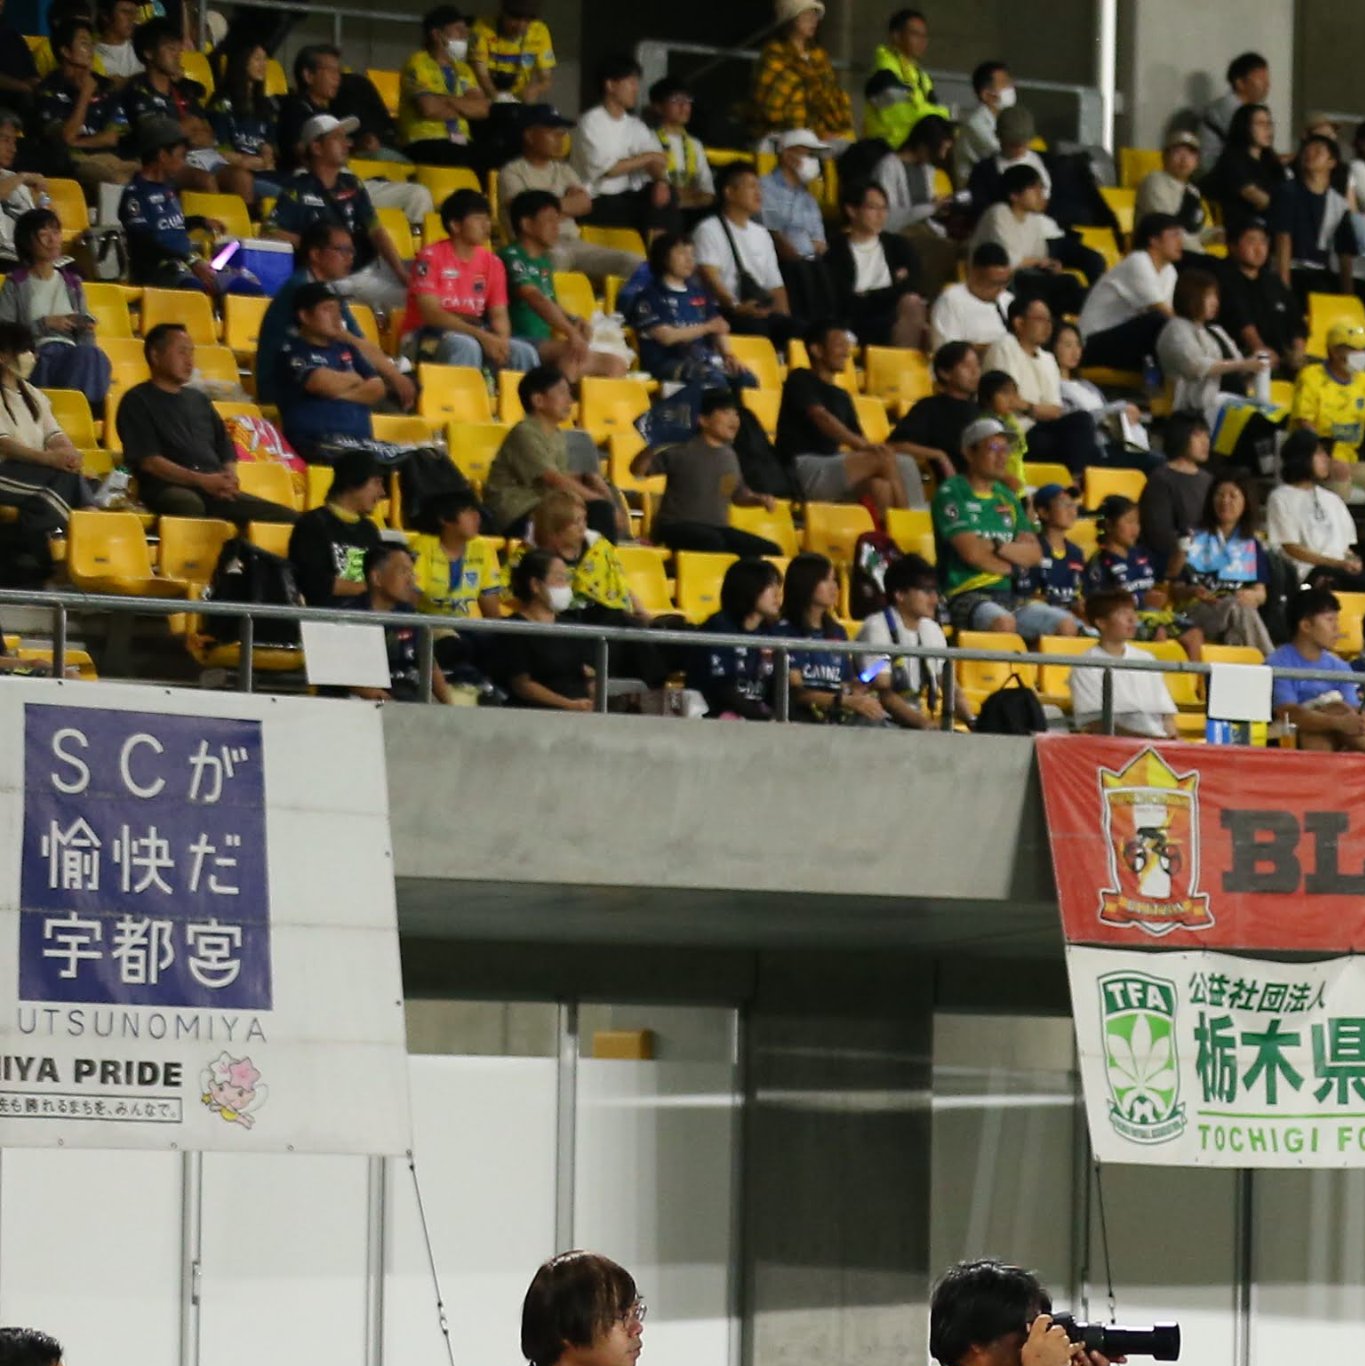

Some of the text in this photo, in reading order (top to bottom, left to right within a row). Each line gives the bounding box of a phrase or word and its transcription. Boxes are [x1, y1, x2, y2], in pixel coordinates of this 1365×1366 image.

[51, 728, 248, 802] SCが
[41, 816, 241, 896] 愉快だ
[42, 911, 242, 988] 宇都宮
[1105, 980, 1168, 1012] TFA
[1189, 971, 1327, 1016] 公益社団法人
[17, 1008, 268, 1043] UTSUNOMIYA
[0, 1055, 183, 1087] IYA PRIDE
[1199, 1124, 1319, 1153] TOCHIGI
